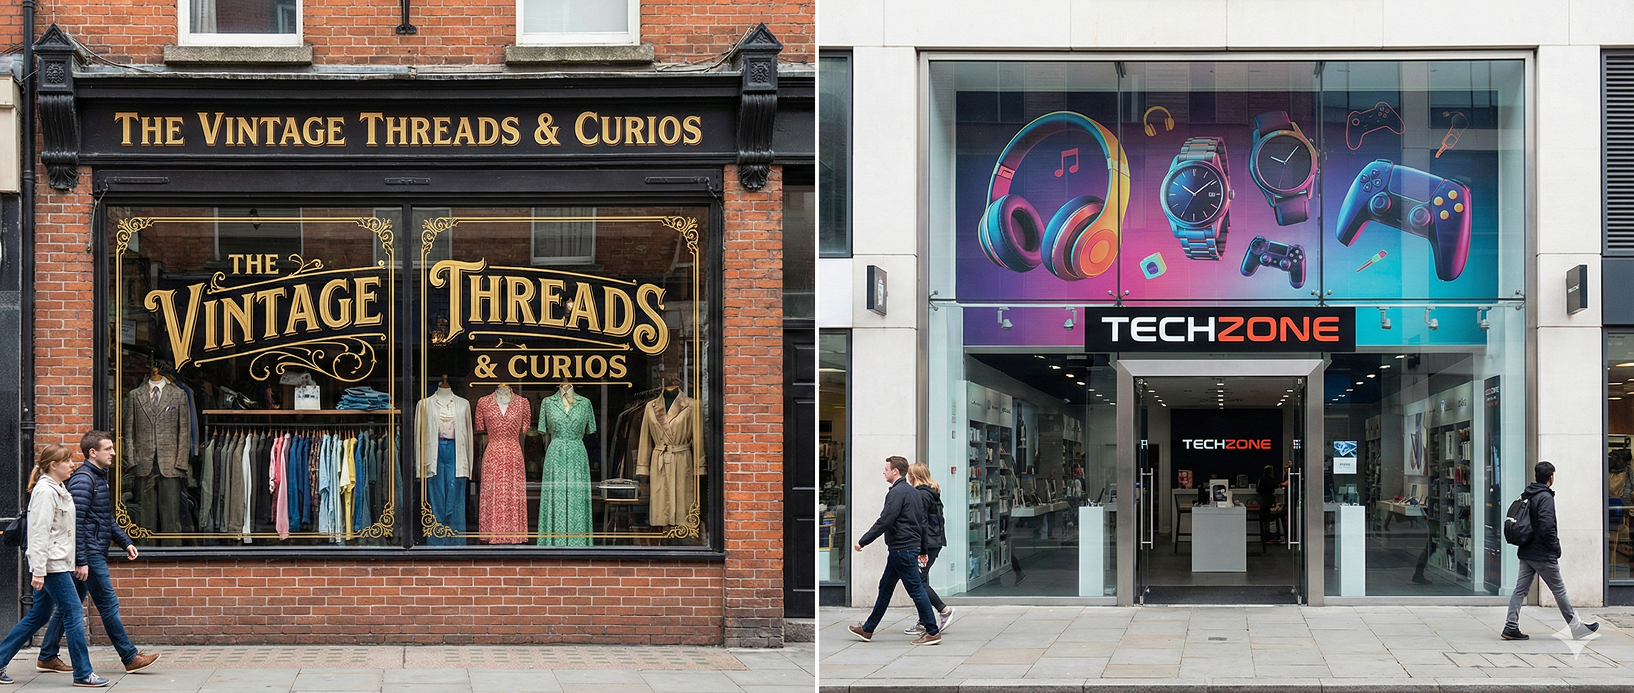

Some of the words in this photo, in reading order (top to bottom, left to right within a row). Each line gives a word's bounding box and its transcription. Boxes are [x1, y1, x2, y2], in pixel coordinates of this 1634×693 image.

[534, 112, 562, 147] &
[229, 254, 279, 275] THE
[1101, 316, 1341, 343] TECHZONE
[474, 354, 498, 379] &
[507, 354, 629, 380] CURIOS
[1182, 438, 1272, 450] TECHZONE
